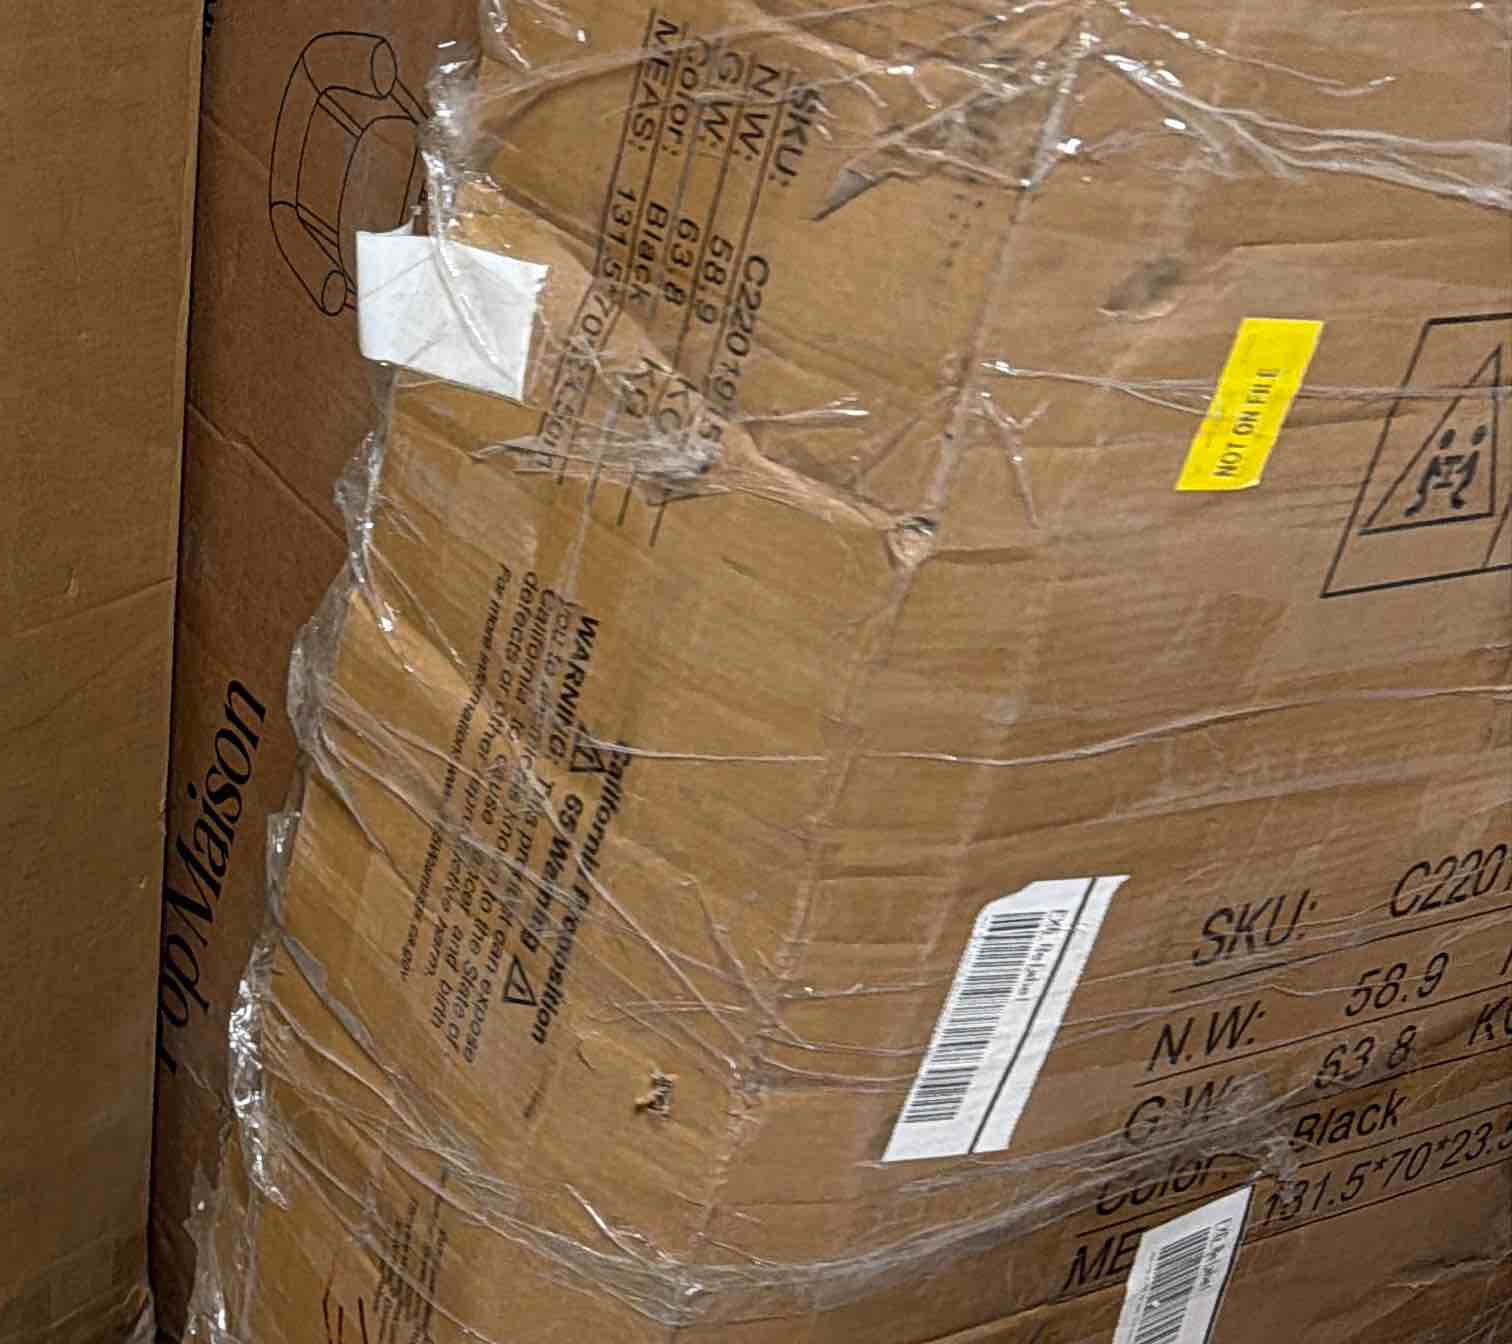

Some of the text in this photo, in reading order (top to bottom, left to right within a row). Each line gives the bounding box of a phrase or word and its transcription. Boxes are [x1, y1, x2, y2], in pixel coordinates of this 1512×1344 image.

[627, 18, 680, 153] MEAS:
[629, 36, 711, 303] Color: Black
[663, 217, 701, 306] 63.8
[1214, 442, 1249, 477] NOT
[1232, 410, 1261, 436] ON
[558, 793, 584, 834] 65
[1192, 887, 1318, 967] SKU:
[1145, 999, 1267, 1073] N.W:
[1345, 951, 1450, 1017] 58.9
[1288, 1087, 1409, 1154] Black
